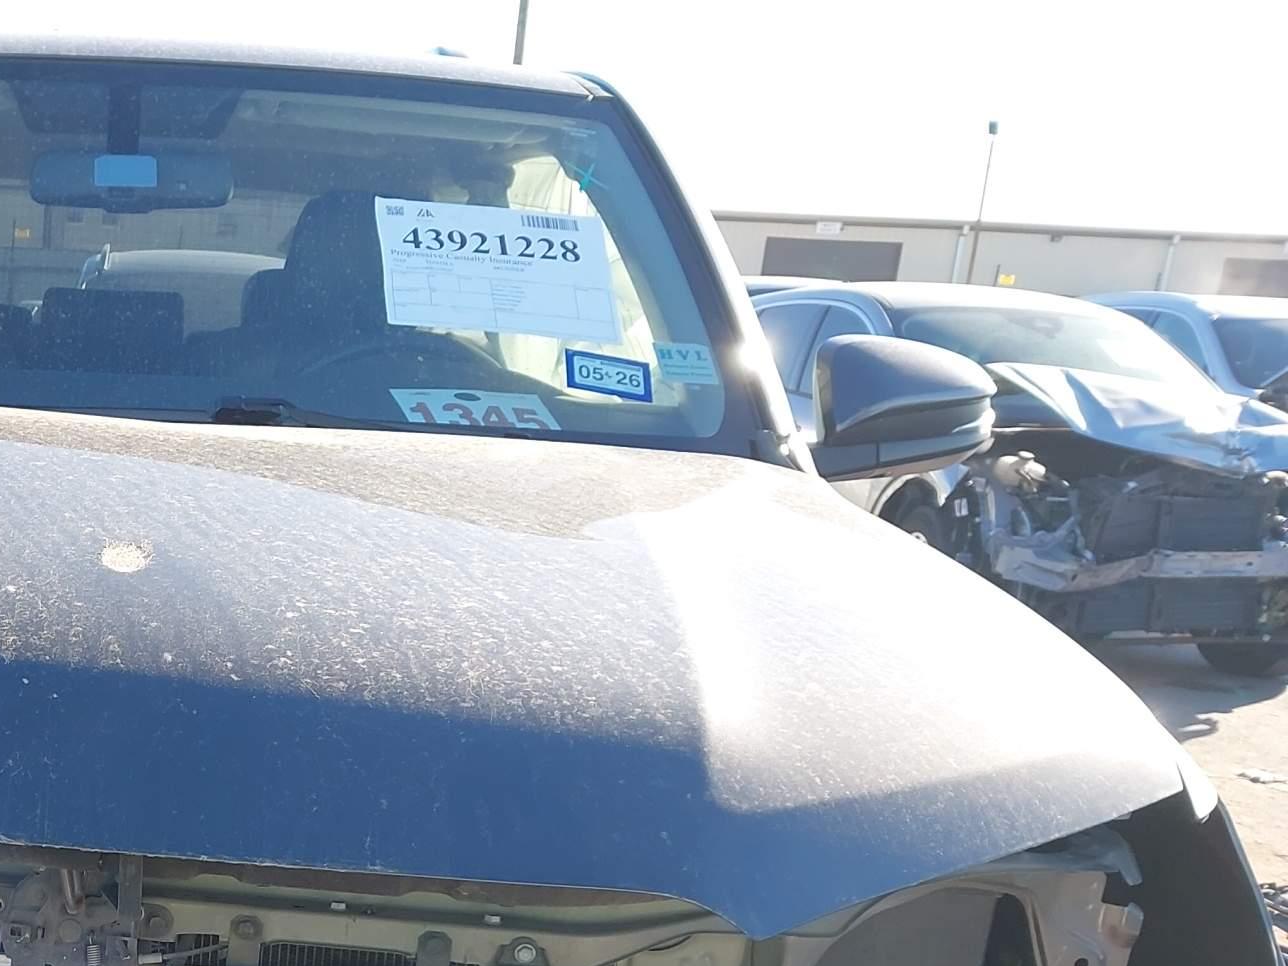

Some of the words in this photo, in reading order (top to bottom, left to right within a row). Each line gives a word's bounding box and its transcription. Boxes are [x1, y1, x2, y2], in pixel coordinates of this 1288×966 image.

[390, 248, 444, 261] Progressive
[445, 252, 486, 264] Casualty
[401, 227, 582, 263] 43921228
[578, 364, 605, 381] 05
[615, 370, 642, 388] 26
[409, 402, 552, 430] 1345
